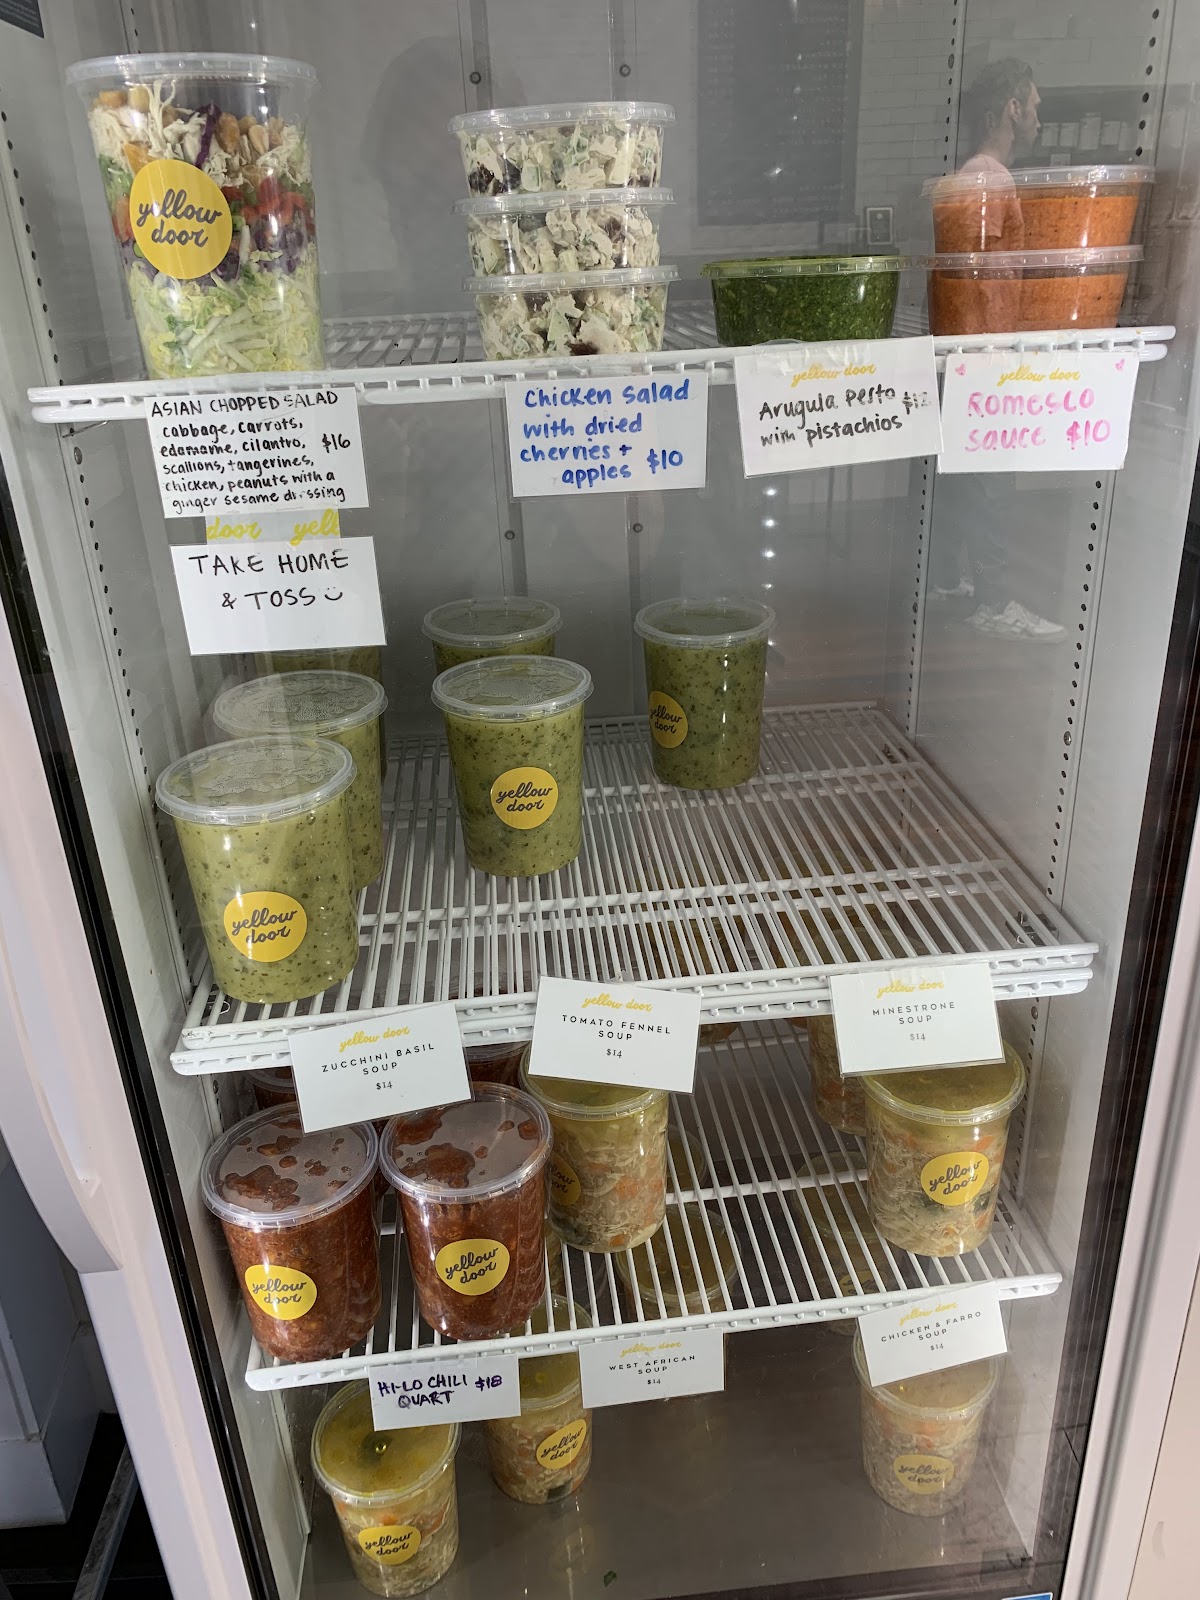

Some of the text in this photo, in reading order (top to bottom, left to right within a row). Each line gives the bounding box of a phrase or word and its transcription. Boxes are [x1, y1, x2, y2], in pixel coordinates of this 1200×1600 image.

[151, 219, 209, 248] door
[790, 362, 877, 388] yellow door
[996, 364, 1081, 387] yellow door
[622, 378, 690, 405] salad
[151, 390, 338, 418] ASIAN CHOPPED SALAD
[759, 392, 839, 430] Arugula
[163, 417, 303, 444] cabbage, carrots,
[523, 412, 643, 439] with dried
[805, 413, 904, 448] pistachios
[1066, 419, 1111, 450] $10
[160, 433, 351, 457] edamame, cilantro, $16
[519, 437, 684, 474] cherries + $10
[163, 455, 314, 477] scallions, tangerines,
[561, 464, 632, 489] apples
[165, 470, 335, 493] chicken, peanuts with a
[172, 497, 217, 515] ginger
[224, 491, 279, 505] sesame
[206, 516, 263, 541] door
[188, 549, 349, 577] TAKE HOME
[221, 587, 316, 610] & TOSS
[654, 718, 677, 734] door
[495, 781, 554, 803] yellow
[506, 798, 545, 812] door
[231, 907, 298, 936] yellow
[245, 925, 291, 944] door
[875, 977, 945, 999] yellow door
[581, 993, 653, 1012] yellow door
[872, 1001, 956, 1016] MINESTRONE
[562, 1014, 671, 1035] TOMATO FENNEL
[898, 1014, 932, 1025] SOUP
[339, 1025, 410, 1053] yellow door
[598, 1030, 633, 1041] SOUP
[909, 1032, 926, 1041] $14
[321, 1043, 435, 1073] ZUCCHINI BASIL
[606, 1048, 623, 1059] $14
[362, 1061, 398, 1075] SOUP
[375, 1081, 393, 1090] $14
[929, 1160, 982, 1192] yellow
[445, 1247, 499, 1280] yellow
[460, 1261, 497, 1284] door
[252, 1278, 307, 1294] yellow
[263, 1293, 302, 1304] door
[899, 1302, 958, 1327] yellow door
[880, 1324, 930, 1342] CHICKEN
[945, 1311, 981, 1325] FARRO
[918, 1328, 947, 1341] SOUP
[620, 1341, 682, 1358] yellow door
[930, 1343, 944, 1351] $14
[608, 1355, 696, 1371] WEST AFRICAN
[638, 1366, 668, 1375] SOUP
[377, 1374, 503, 1397] HI-LO CHILI $18
[398, 1390, 455, 1409] QUART
[540, 1427, 584, 1459] yellow
[549, 1440, 579, 1461] door
[364, 1531, 414, 1550] yellow
[376, 1542, 410, 1556] door
